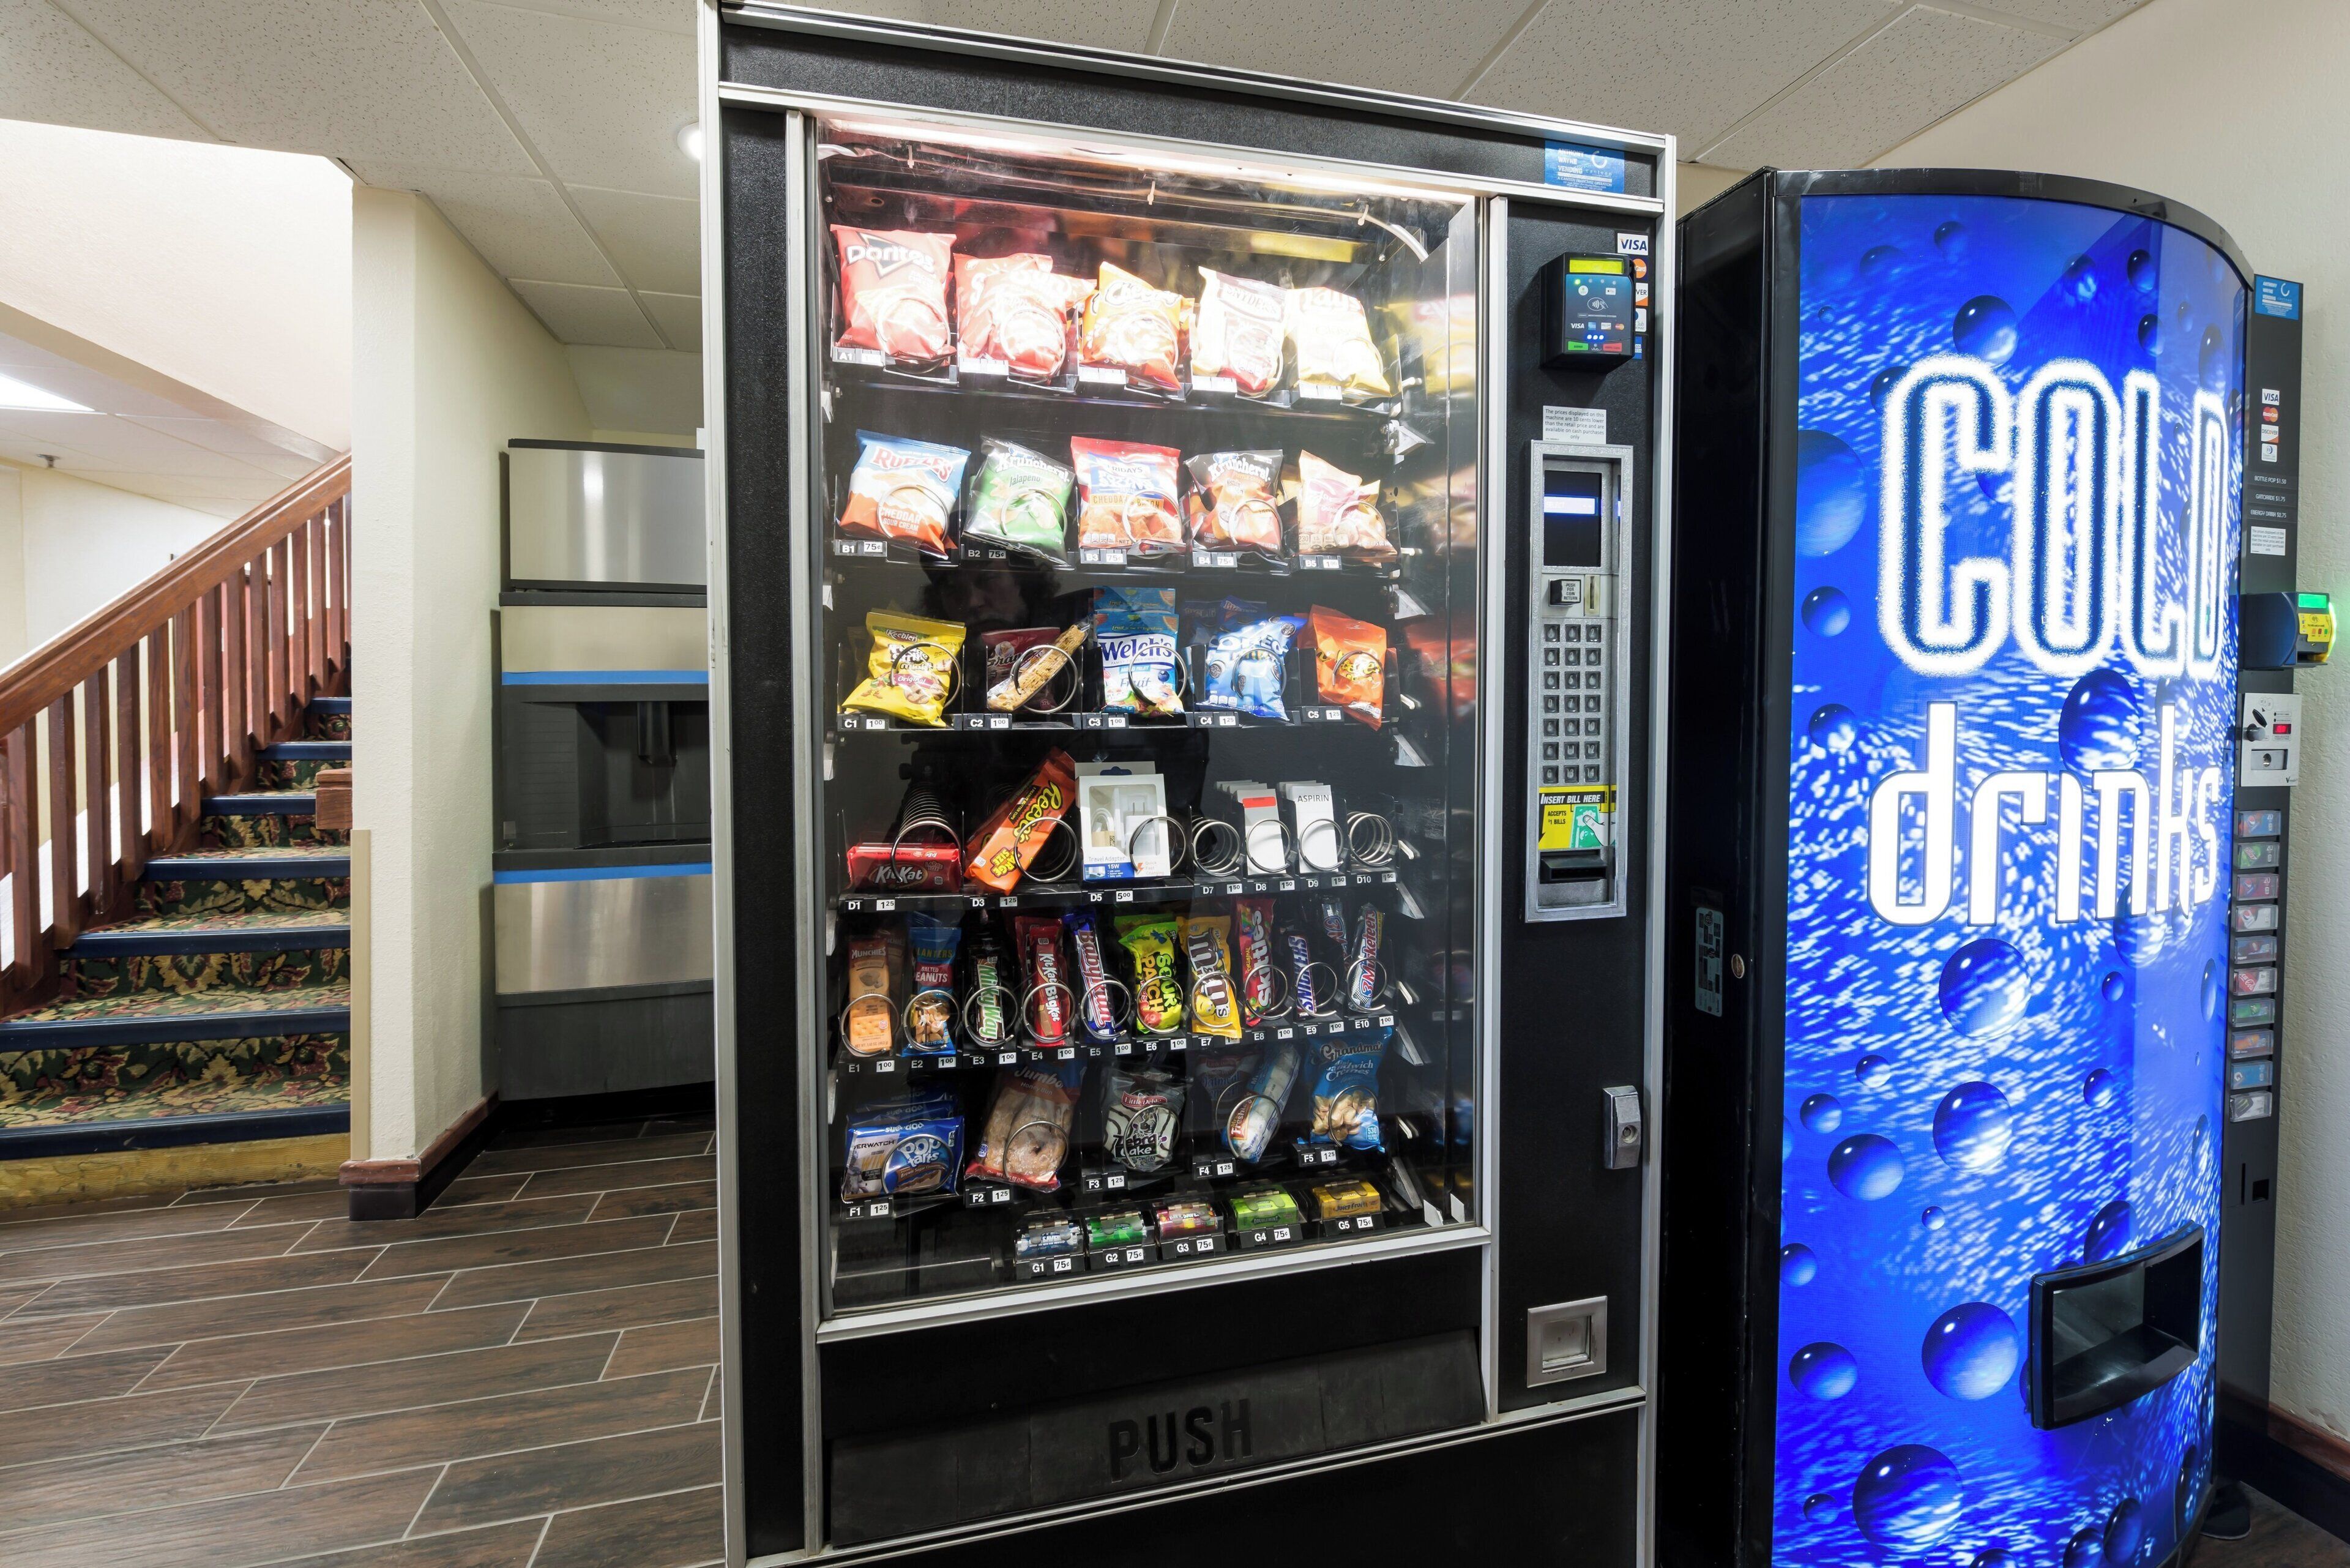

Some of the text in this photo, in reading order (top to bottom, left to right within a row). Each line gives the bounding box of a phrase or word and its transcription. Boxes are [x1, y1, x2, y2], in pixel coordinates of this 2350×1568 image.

[1557, 165, 1583, 174] VENDING
[1621, 239, 1647, 251] VISA
[846, 244, 935, 274] Doritos
[839, 352, 852, 361] A1
[2264, 393, 2279, 402] VISA
[870, 446, 953, 482] RUFFLES
[1878, 352, 2229, 681] COLD
[882, 517, 919, 531] SOUR CREAM
[842, 545, 855, 553] B1
[887, 630, 917, 642] Keebler
[1099, 637, 1173, 662] Welch's
[897, 676, 927, 684] Original
[845, 719, 857, 728] C1
[970, 719, 983, 728] C2
[1088, 718, 1102, 726] C3
[1199, 717, 1213, 725] C4
[1297, 794, 1330, 803] ASPIRIN
[1540, 794, 1565, 804] INSERT
[1867, 700, 2220, 927] drinks
[992, 848, 1010, 867] SIZE
[1308, 879, 1319, 887] D9
[1356, 875, 1372, 884] D10
[1203, 886, 1214, 895] D7
[1255, 883, 1267, 892] D8
[972, 898, 985, 907] D3
[1090, 894, 1103, 902] D5
[848, 901, 860, 910] D1
[1362, 909, 1377, 981] Musketeers
[851, 947, 886, 960] MUNCHIES
[1253, 910, 1273, 1007] Skittles
[915, 973, 948, 983] EANUTS
[1142, 955, 1165, 1013] PATCH
[977, 964, 1004, 1040] Milky Way
[1354, 1020, 1370, 1029] E10
[1254, 1032, 1265, 1041] E8
[1201, 1037, 1212, 1047] E7
[1146, 1043, 1157, 1051] E6
[1321, 1041, 1383, 1061] Grandma's
[1090, 1048, 1102, 1056] E5
[911, 1060, 923, 1069] E2
[972, 1056, 985, 1065] E3
[848, 1064, 860, 1072] E1
[1014, 1066, 1064, 1089] Jumbo
[1020, 1081, 1040, 1092] Honey
[1124, 1096, 1141, 1105] Little
[1113, 1133, 1158, 1146] Zebra
[854, 1140, 895, 1150] VERWATCH
[1120, 1146, 1153, 1157] Cake
[1199, 1167, 1210, 1176] F4
[1089, 1180, 1100, 1189] F3
[972, 1194, 983, 1203] F2
[849, 1208, 860, 1216] F1
[1338, 1220, 1350, 1230] G5
[1255, 1230, 1288, 1242] G4 75¢
[1176, 1241, 1212, 1253] G3 75¢
[1105, 1250, 1142, 1263] G2 75¢
[1032, 1261, 1070, 1272] G1 75¢
[1109, 1398, 1253, 1484] PUSH
